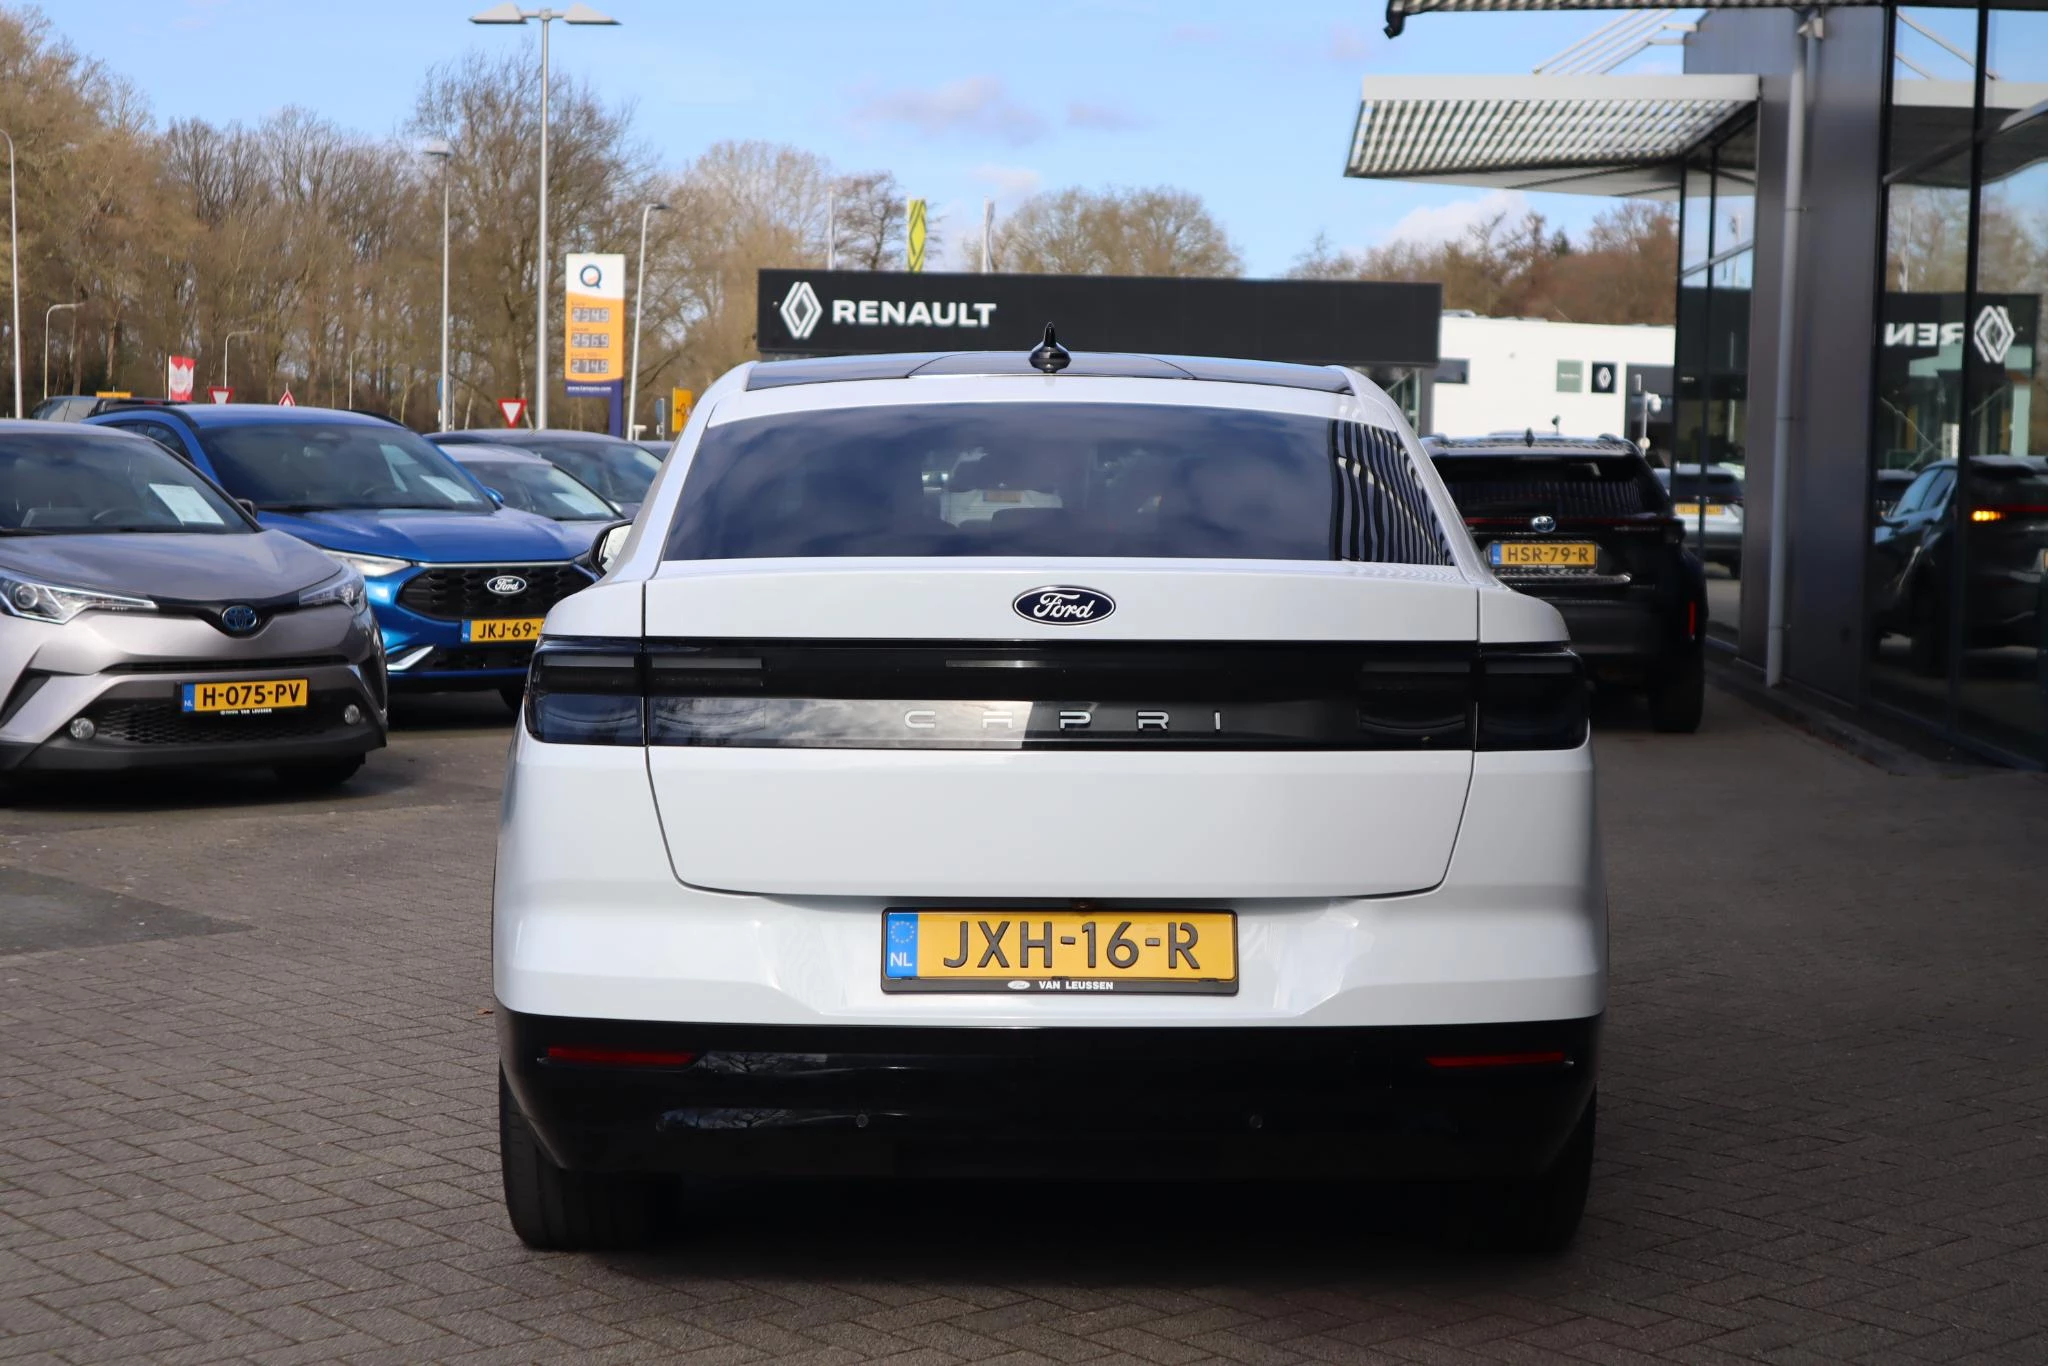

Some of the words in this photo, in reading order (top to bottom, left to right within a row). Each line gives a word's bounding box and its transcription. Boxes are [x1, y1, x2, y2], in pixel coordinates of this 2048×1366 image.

[832, 299, 997, 327] RENAULT
[1508, 547, 1589, 562] HSR-79-R
[495, 578, 519, 592] Ford
[1033, 593, 1096, 618] Ford
[202, 683, 301, 707] H-075-PV
[904, 710, 1222, 731] CAPRI
[943, 920, 1201, 969] JXH-16-R
[890, 952, 912, 967] NL
[1038, 980, 1061, 990] VAN
[1065, 980, 1114, 991] LEUSSEN
